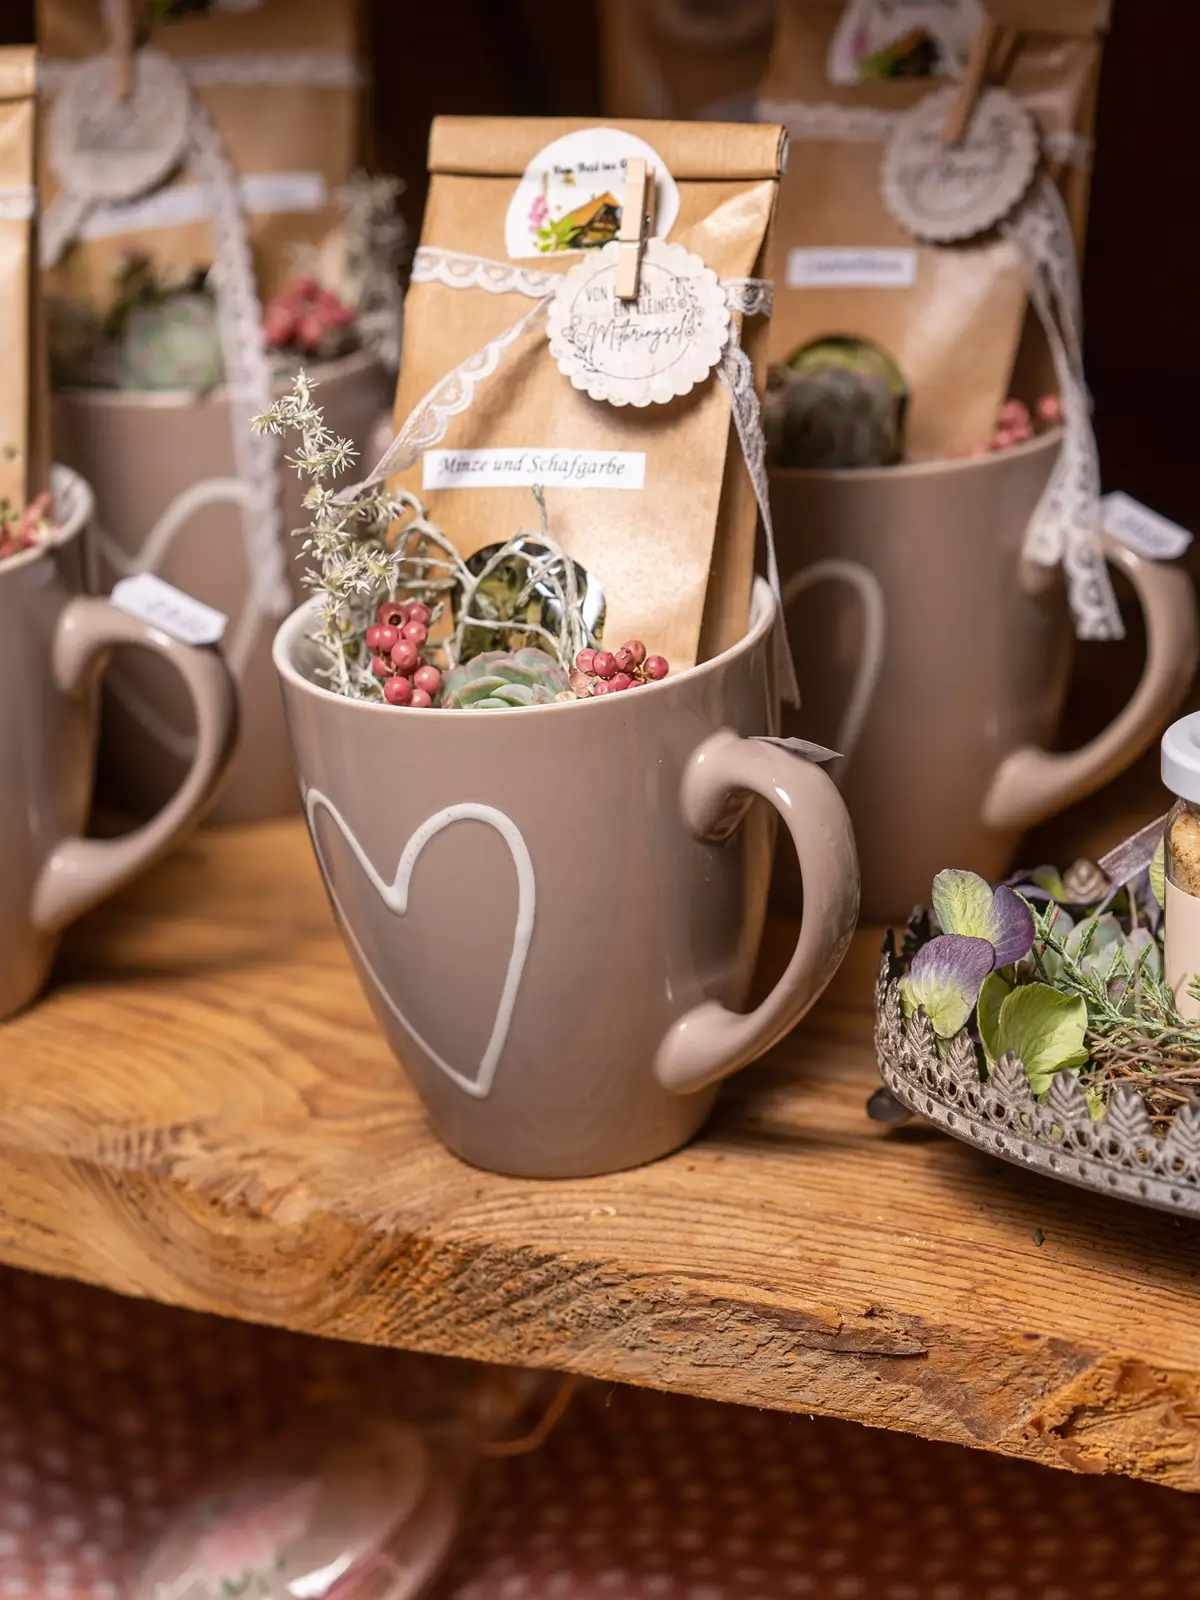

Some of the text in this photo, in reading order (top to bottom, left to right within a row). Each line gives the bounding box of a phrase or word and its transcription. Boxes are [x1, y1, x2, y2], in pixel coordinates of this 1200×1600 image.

[586, 285, 608, 301] VON
[439, 452, 626, 480] Minze und Schafgarbe
